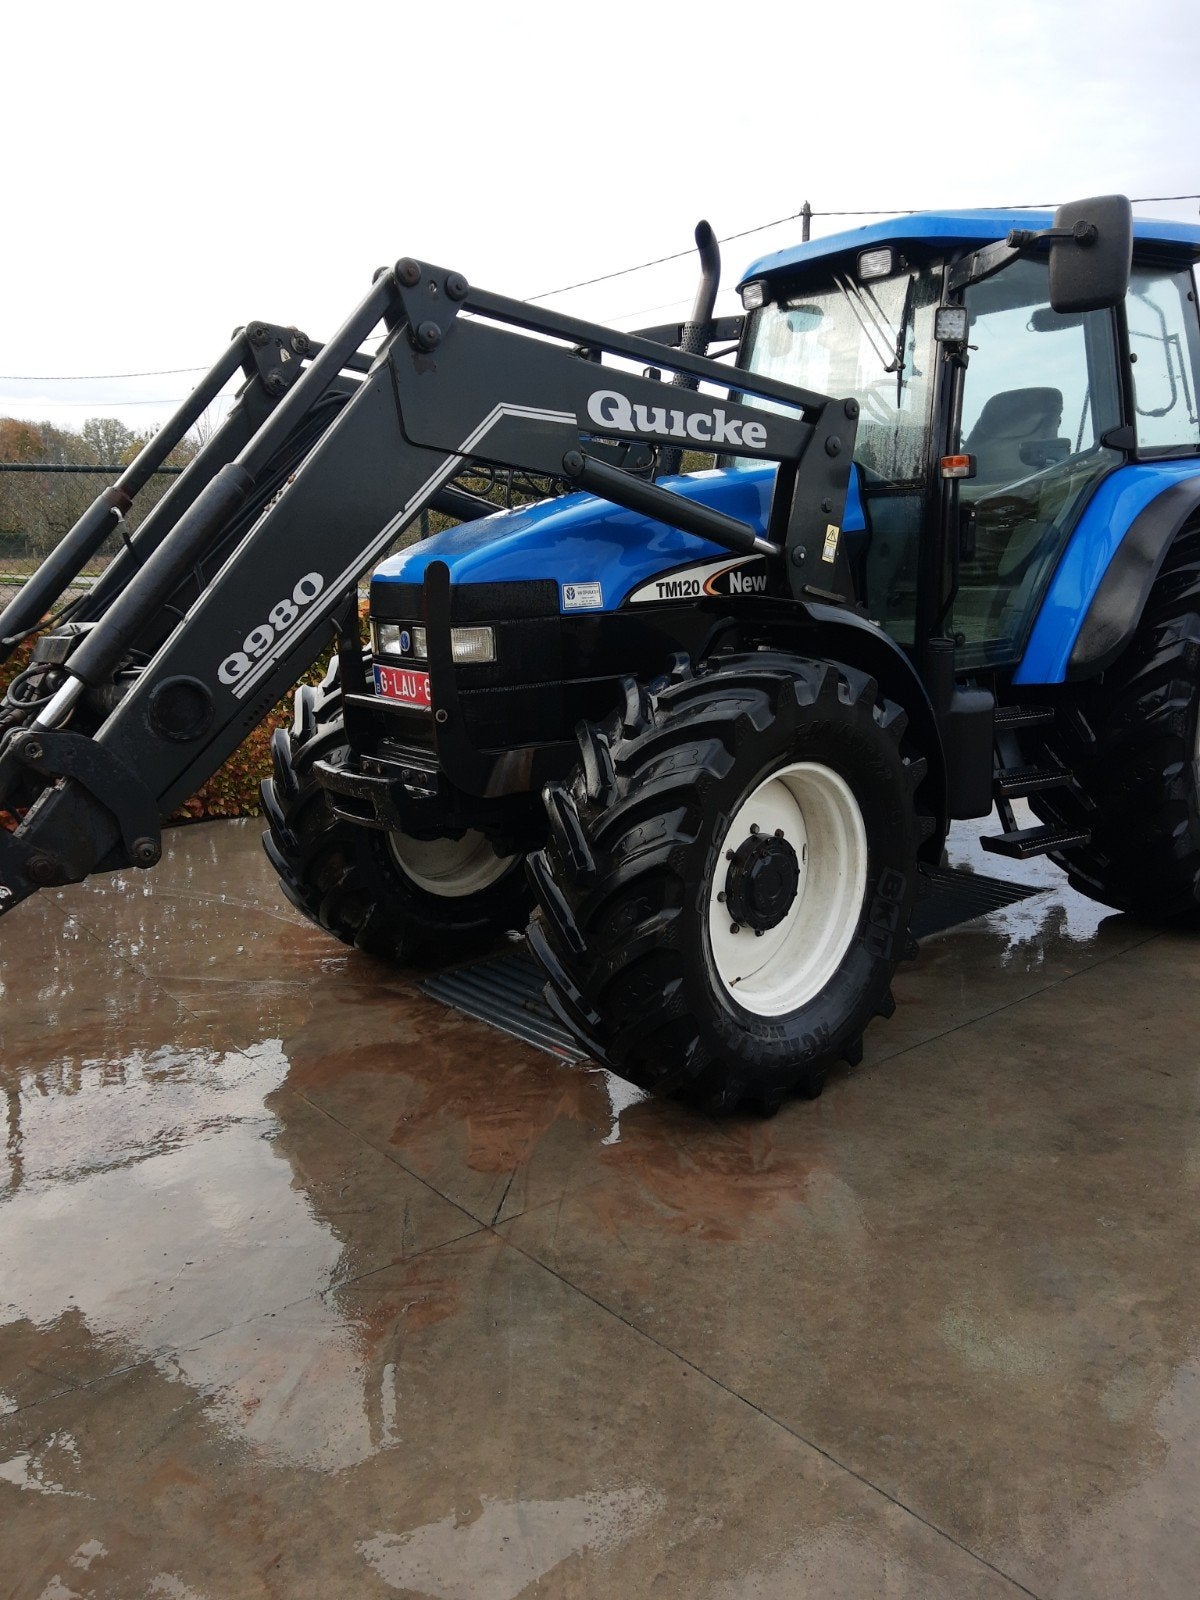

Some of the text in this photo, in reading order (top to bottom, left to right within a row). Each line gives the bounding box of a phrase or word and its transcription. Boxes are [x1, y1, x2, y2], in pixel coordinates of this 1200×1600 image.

[587, 389, 768, 449] Quicke
[655, 579, 700, 599] TM120
[729, 571, 767, 594] New
[217, 571, 324, 685] Q980
